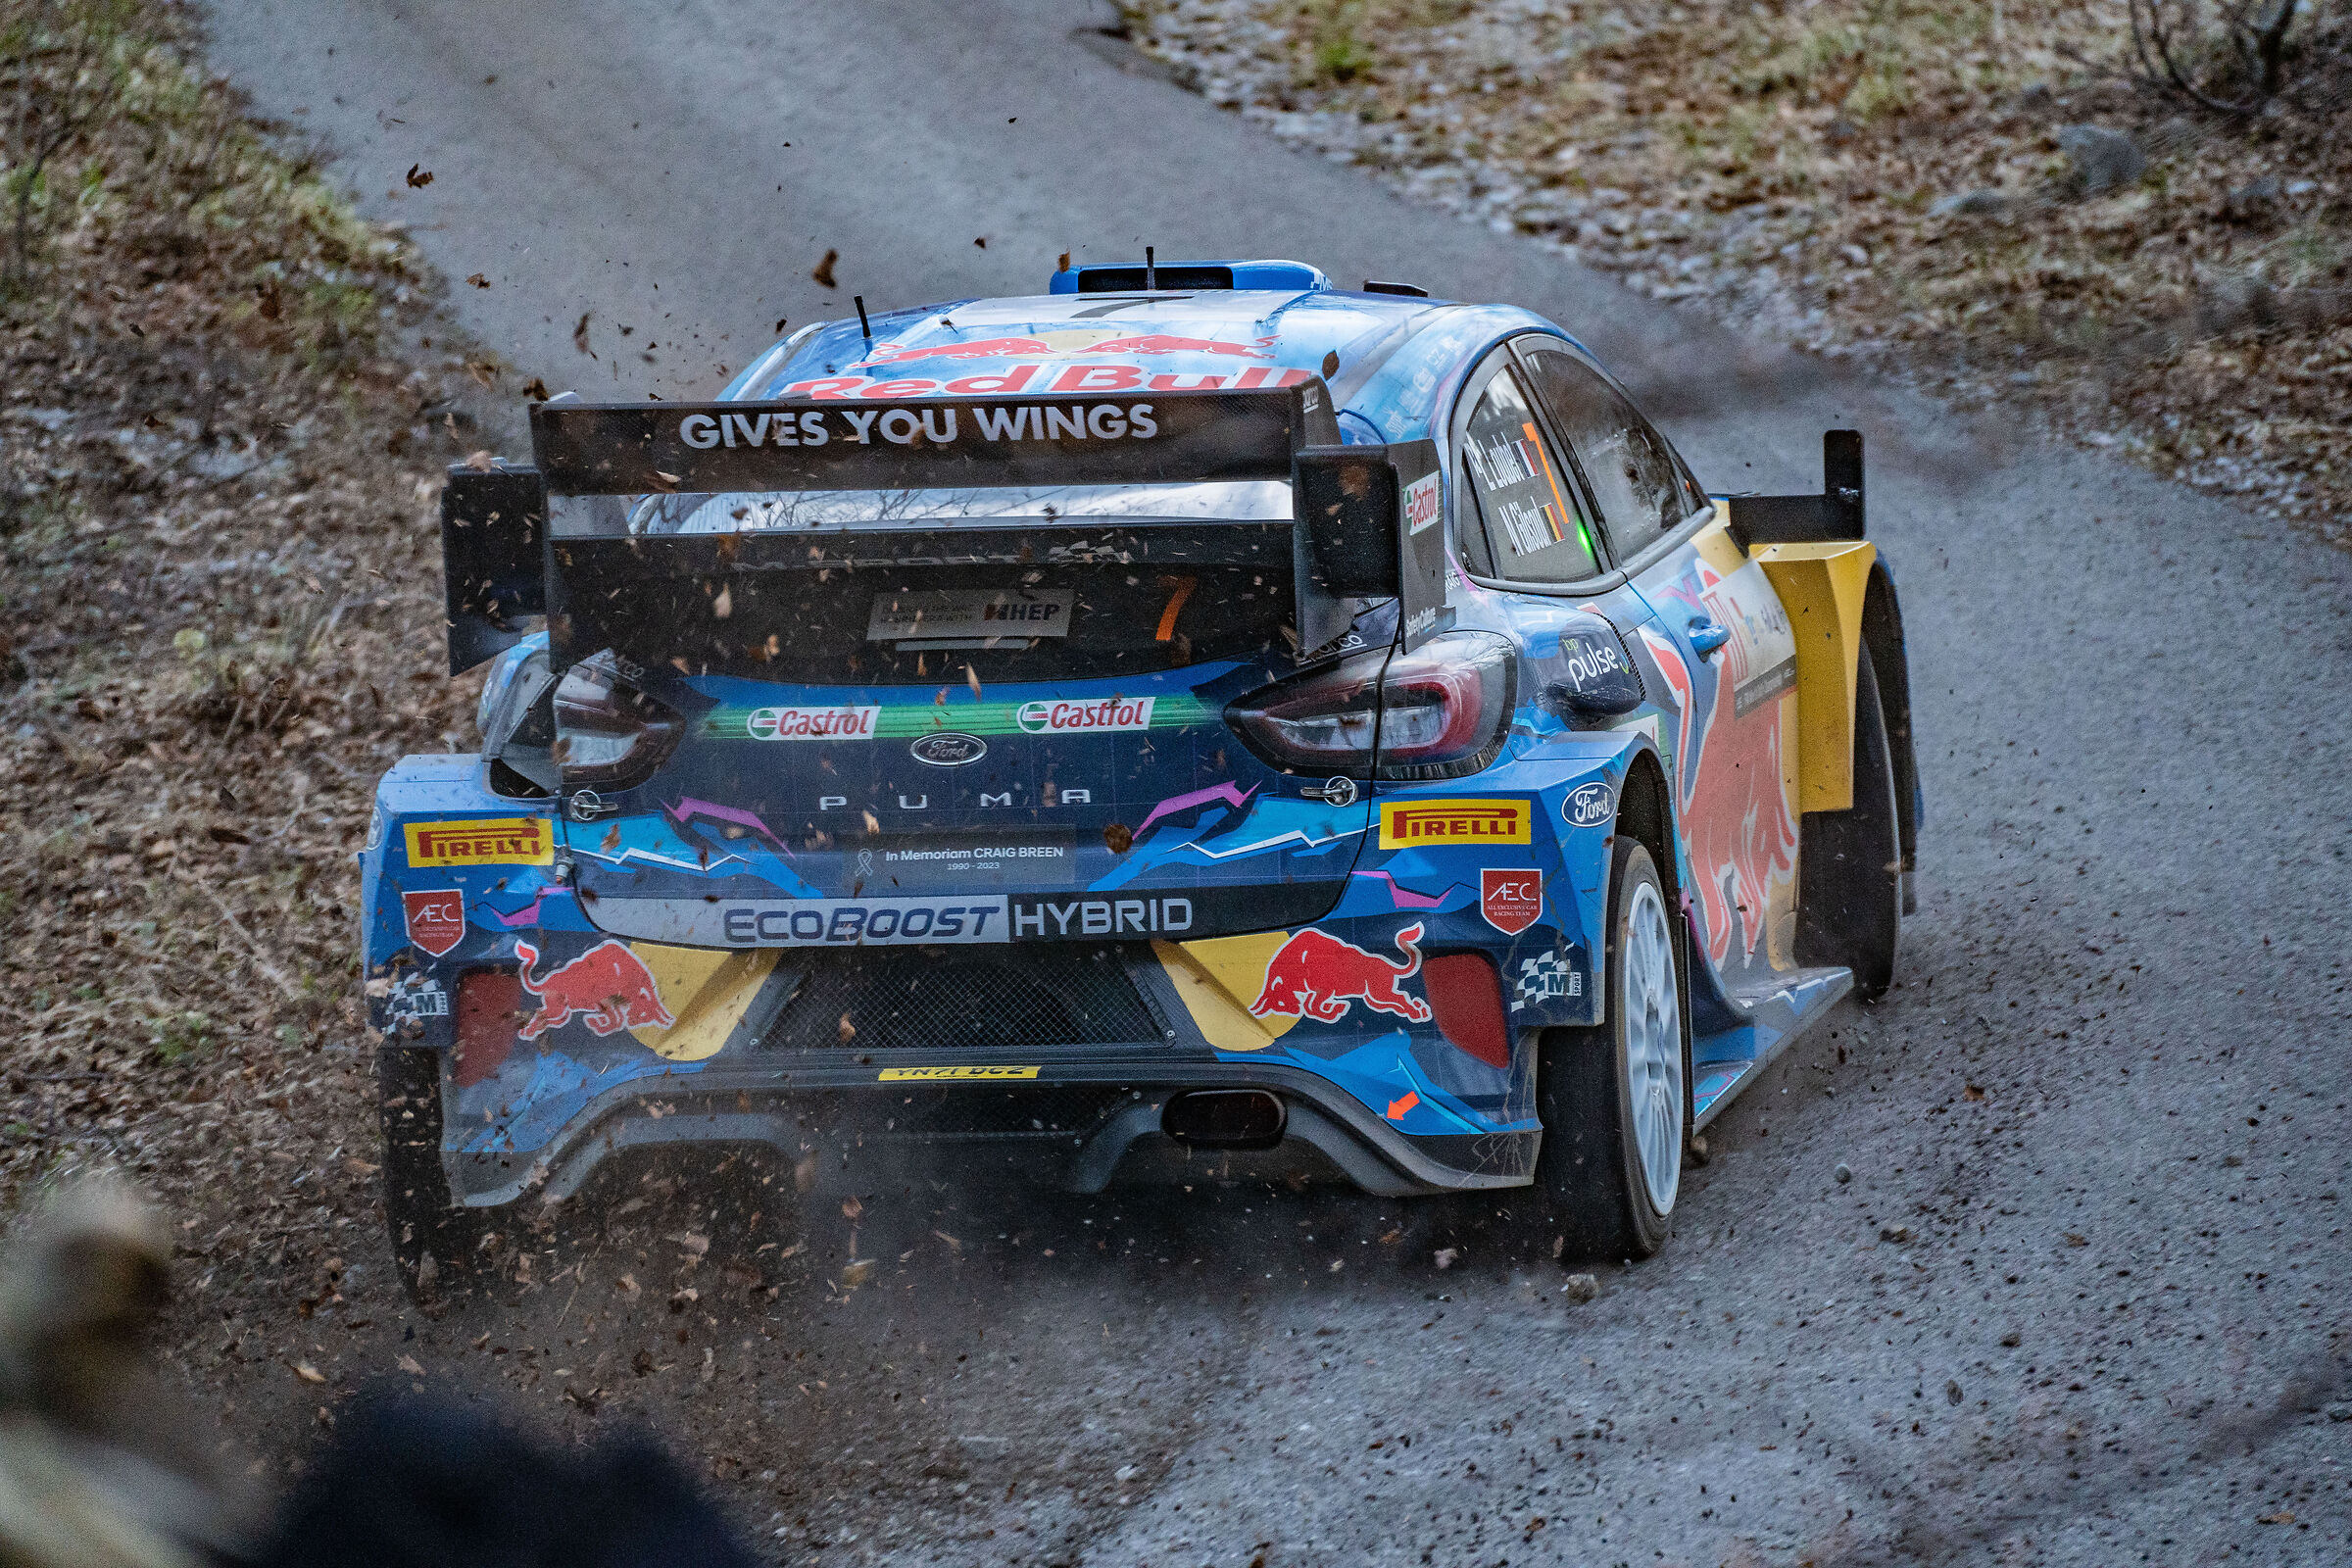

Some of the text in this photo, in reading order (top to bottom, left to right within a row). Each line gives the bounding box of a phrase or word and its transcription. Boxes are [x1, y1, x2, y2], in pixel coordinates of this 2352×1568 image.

[1070, 296, 1195, 318] 7
[786, 365, 1312, 399] Red Bull
[679, 404, 1158, 449] GIVES YOU WINGS
[1478, 431, 1526, 488] Loubet
[1412, 478, 1437, 527] Castrol
[1508, 495, 1552, 554] Gilsoul
[1154, 574, 1198, 640] 7
[1560, 638, 1579, 653] bp
[1568, 642, 1619, 693] pulse
[779, 709, 870, 736] Castrol
[1050, 700, 1145, 729] Castrol
[926, 739, 969, 760] Ford
[819, 789, 1091, 810] PUMA
[1574, 787, 1611, 823] Ford
[1393, 808, 1518, 840] PIRELLI
[416, 827, 542, 858] PIRELLI
[885, 847, 1064, 861] In Memoriam CRAIG BREEN
[977, 861, 1001, 870] 2023
[723, 898, 1194, 944] ECOBOOST HYBRID
